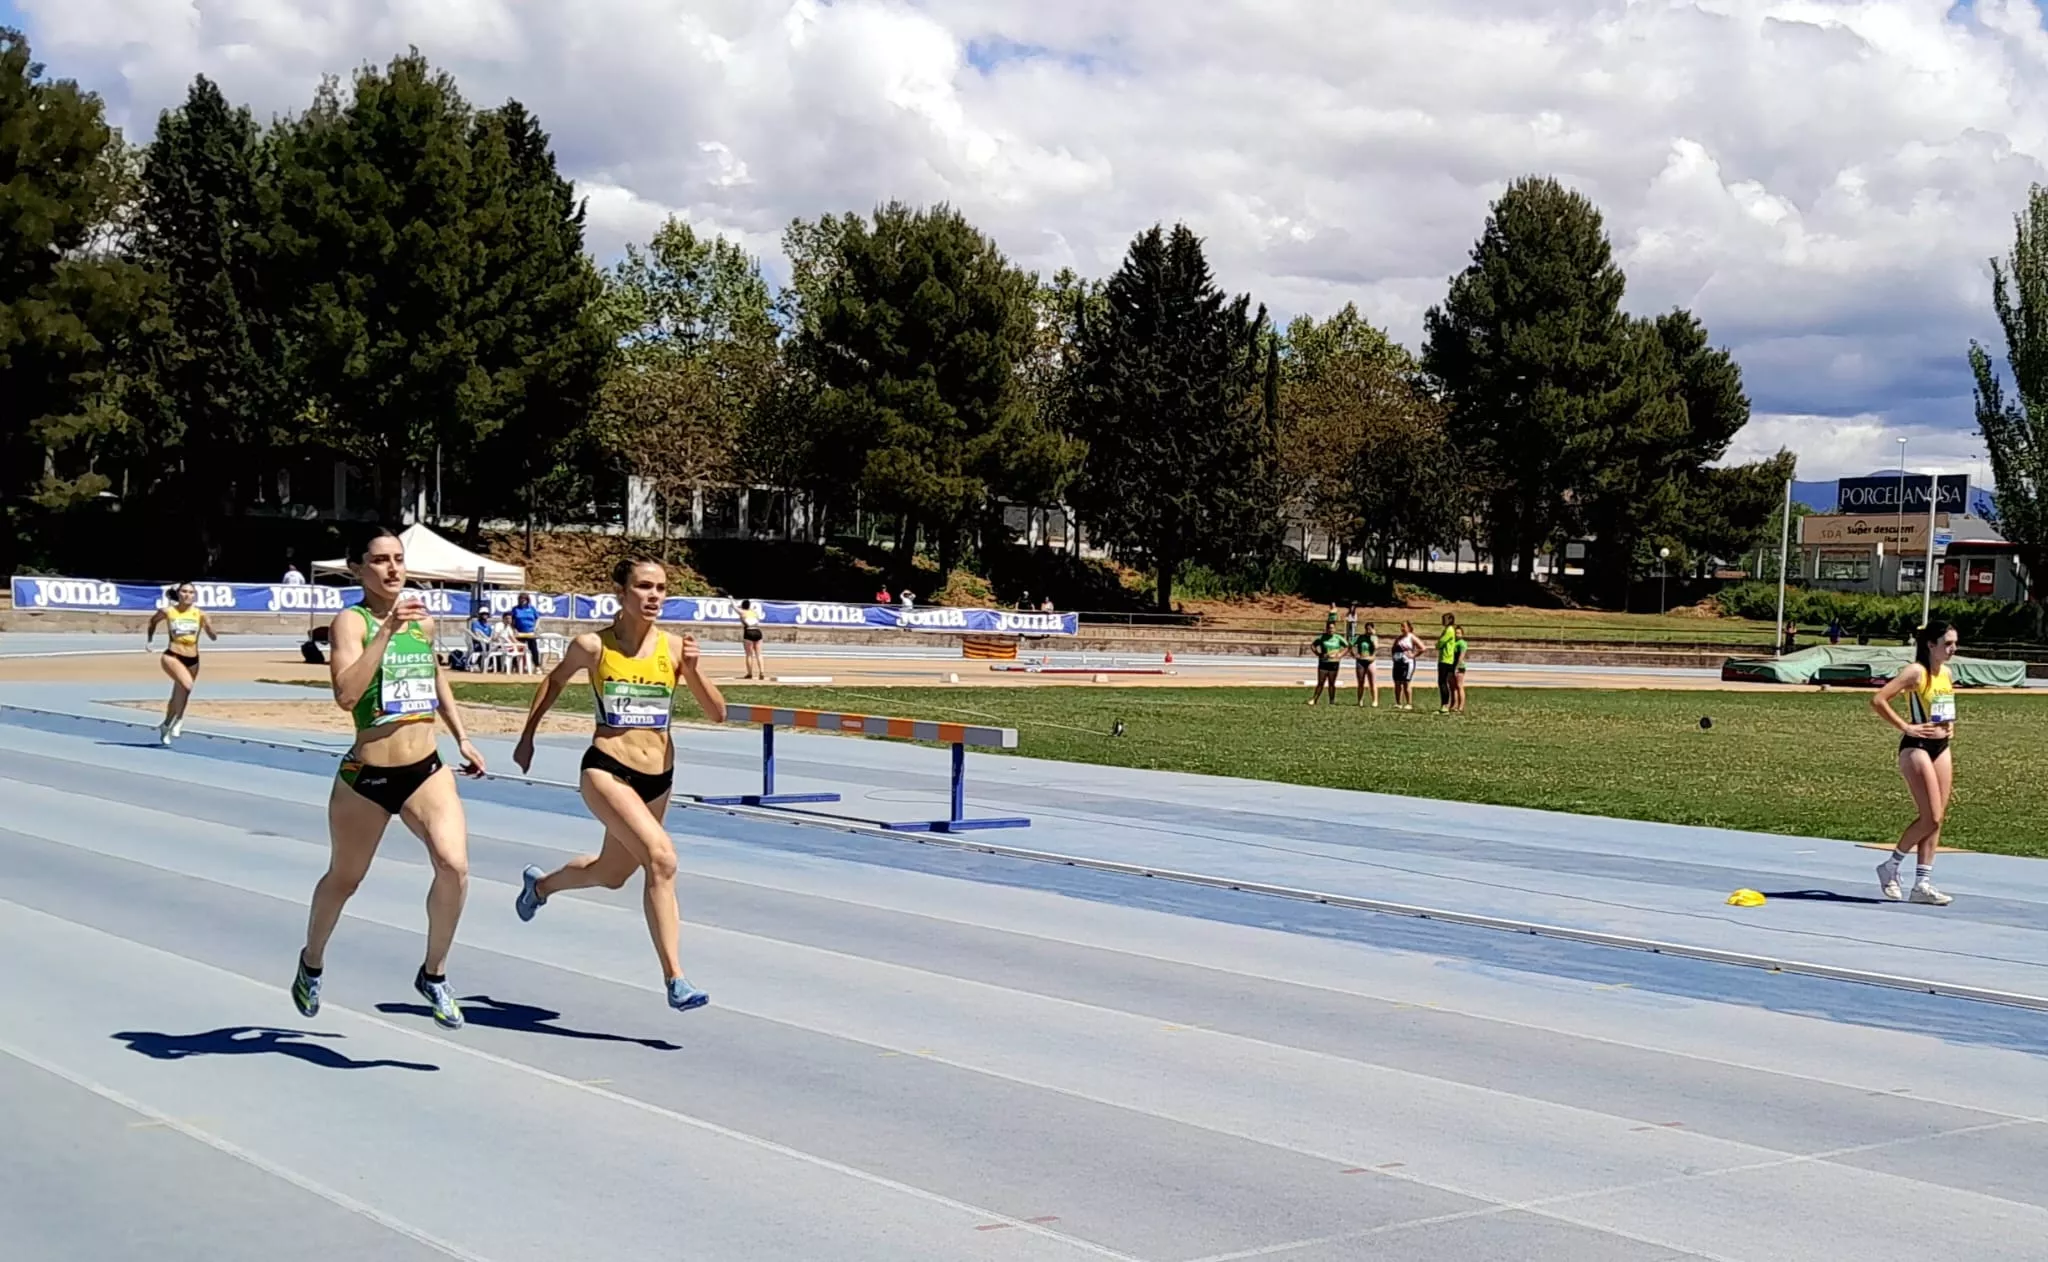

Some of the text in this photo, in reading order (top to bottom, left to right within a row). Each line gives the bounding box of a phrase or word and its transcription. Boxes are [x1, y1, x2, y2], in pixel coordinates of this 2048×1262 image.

[1840, 485, 1961, 505] PORCELANOSA
[156, 585, 236, 608] Jma
[393, 680, 410, 699] 23
[616, 697, 631, 712] 12
